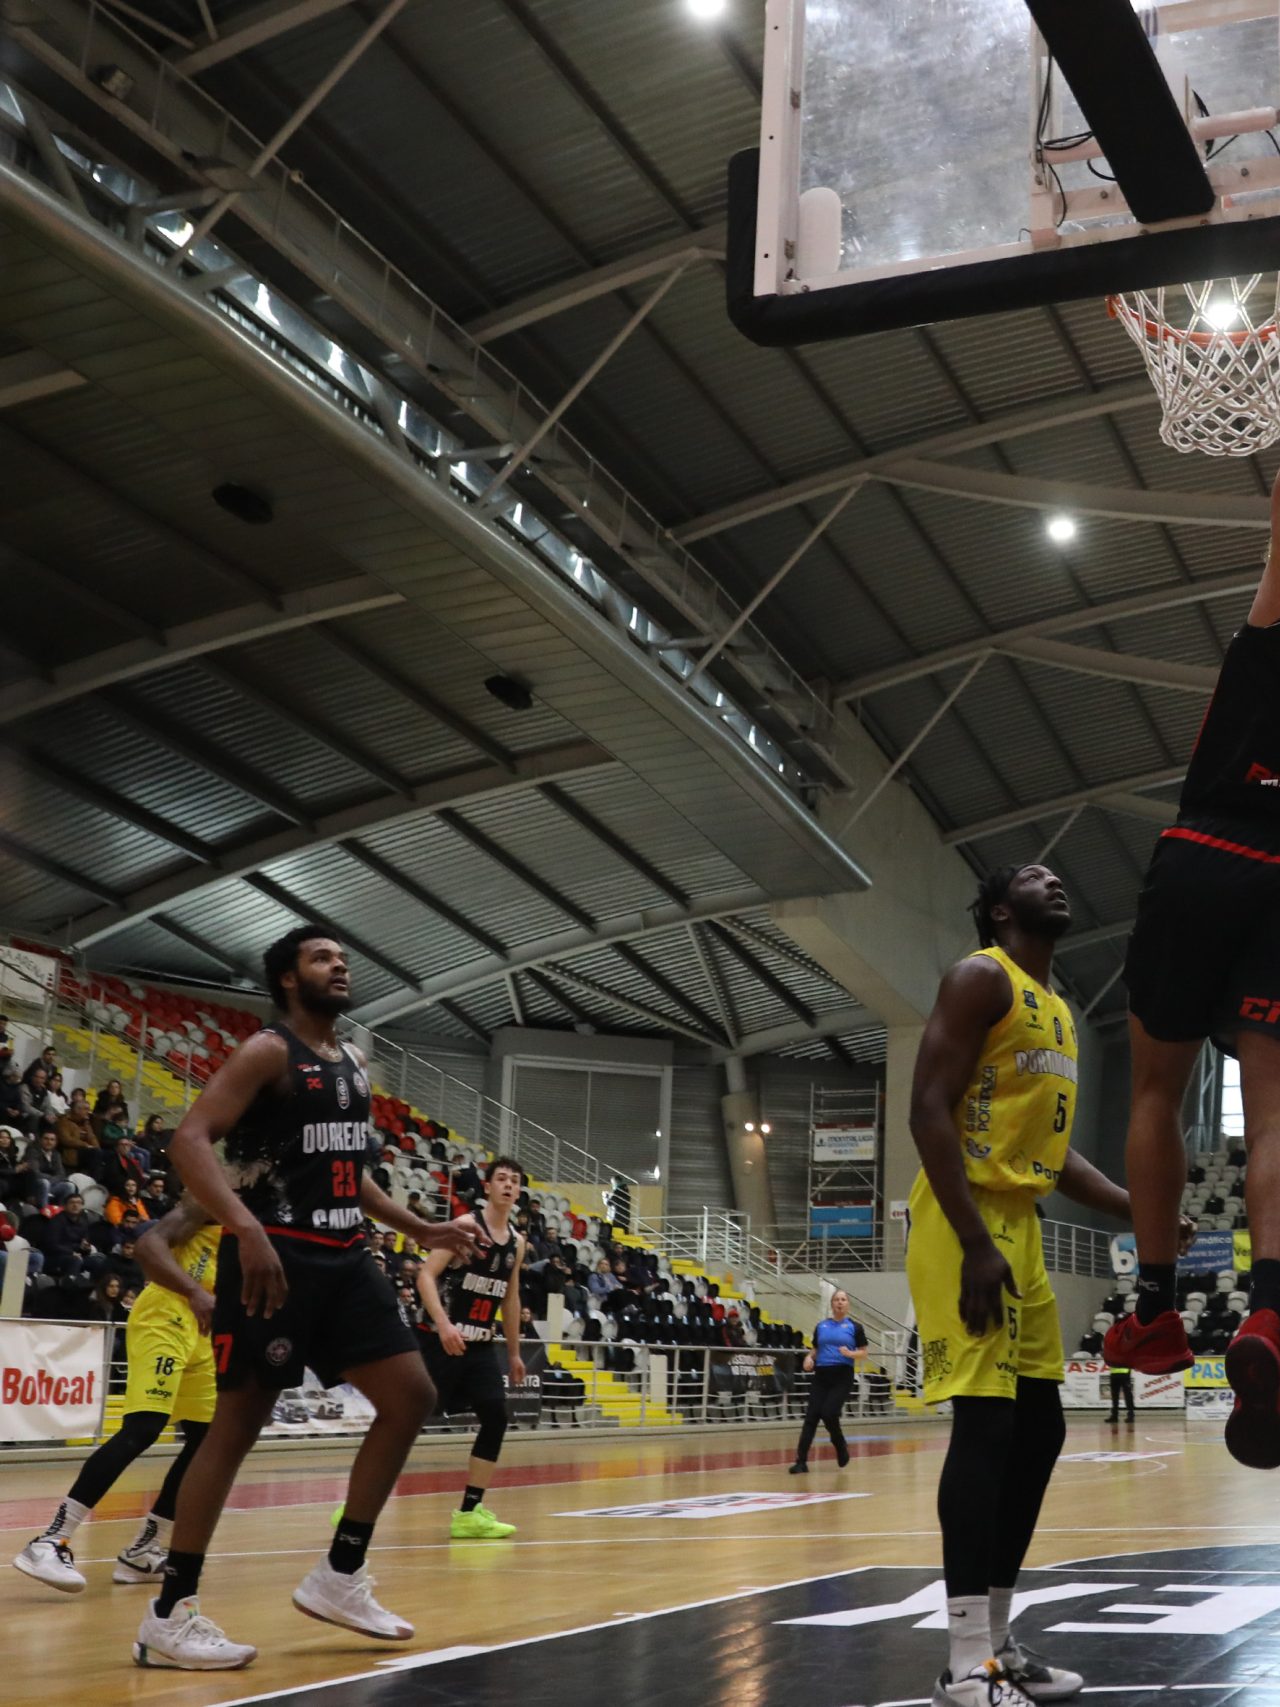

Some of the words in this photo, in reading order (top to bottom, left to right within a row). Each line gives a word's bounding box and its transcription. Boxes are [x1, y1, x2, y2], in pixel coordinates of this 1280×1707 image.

[1053, 1092, 1068, 1134] 5
[331, 1160, 357, 1197] 23
[468, 1298, 493, 1321] 20
[1007, 1305, 1018, 1340] 5
[155, 1356, 175, 1376] 18
[2, 1367, 95, 1406] Bobcat
